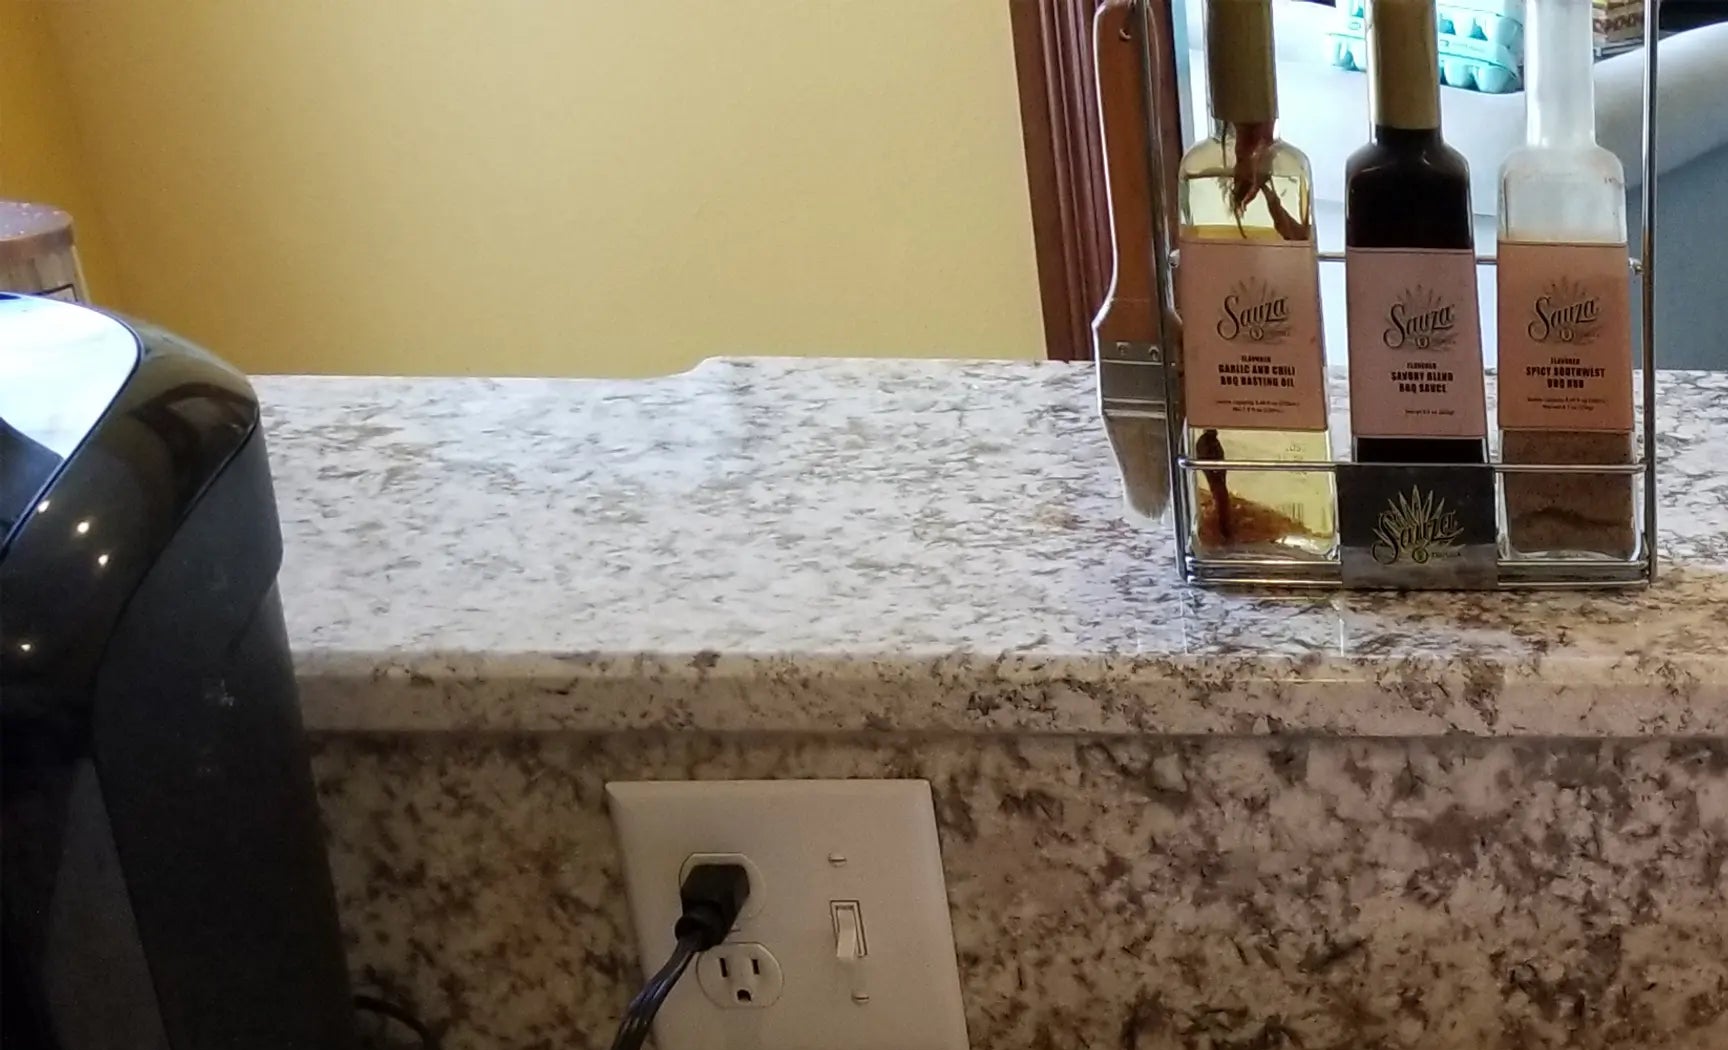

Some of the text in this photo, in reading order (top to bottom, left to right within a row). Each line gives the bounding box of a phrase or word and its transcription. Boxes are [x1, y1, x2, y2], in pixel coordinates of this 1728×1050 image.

[1217, 295, 1288, 341] Sauza
[1527, 296, 1599, 342] Sauza
[1383, 303, 1455, 349] Sauza
[1218, 364, 1296, 376] GARLIC AND CHILI
[1391, 371, 1425, 381] SAVORY
[1526, 366, 1606, 378] SPICY SOUTHWEST
[1241, 376, 1279, 387] BASTING
[1281, 378, 1295, 388] OIL
[1419, 383, 1447, 393] SAUCE
[1372, 510, 1457, 565] Sauza
